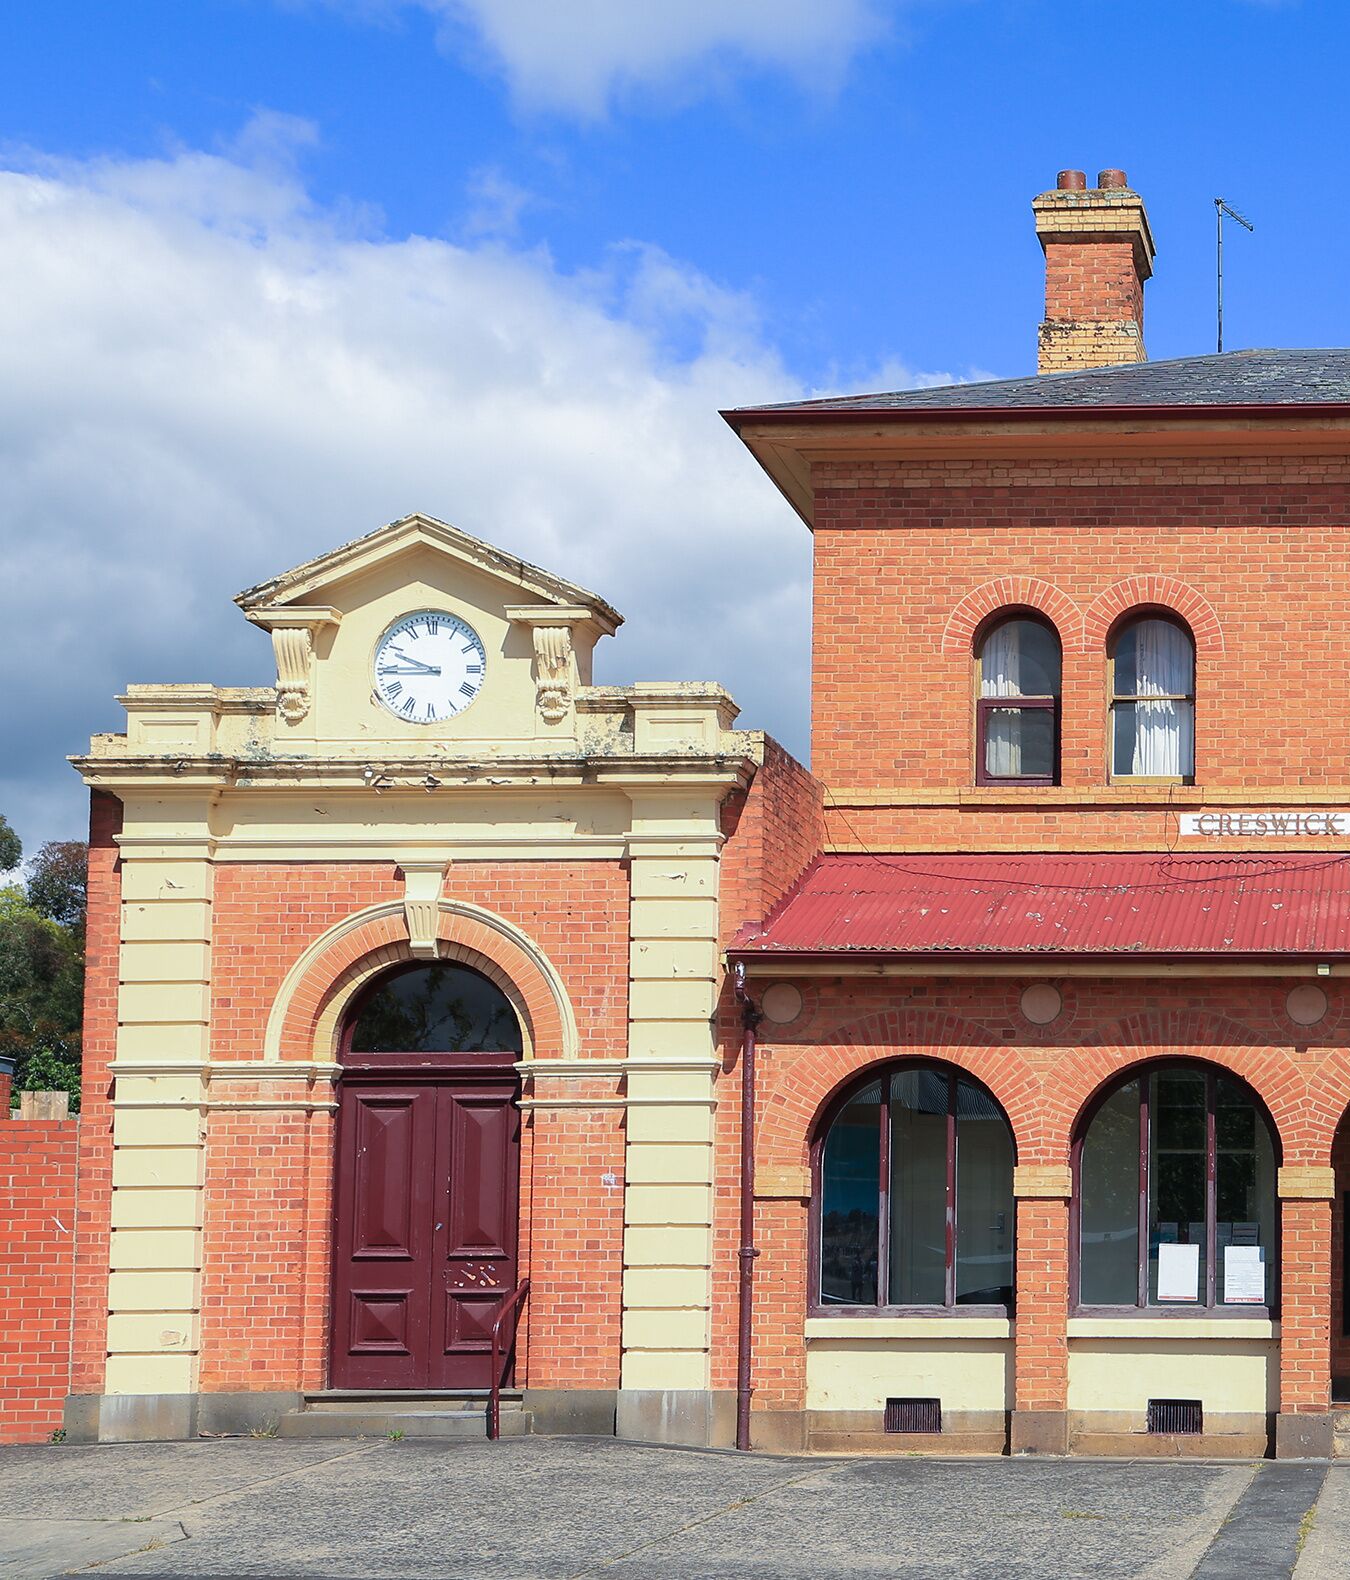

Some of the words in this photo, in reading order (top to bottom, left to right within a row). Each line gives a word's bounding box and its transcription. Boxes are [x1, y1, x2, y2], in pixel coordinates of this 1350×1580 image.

[461, 642, 477, 655] II
[466, 665, 481, 673] III
[1196, 813, 1341, 837] CRESWICK
